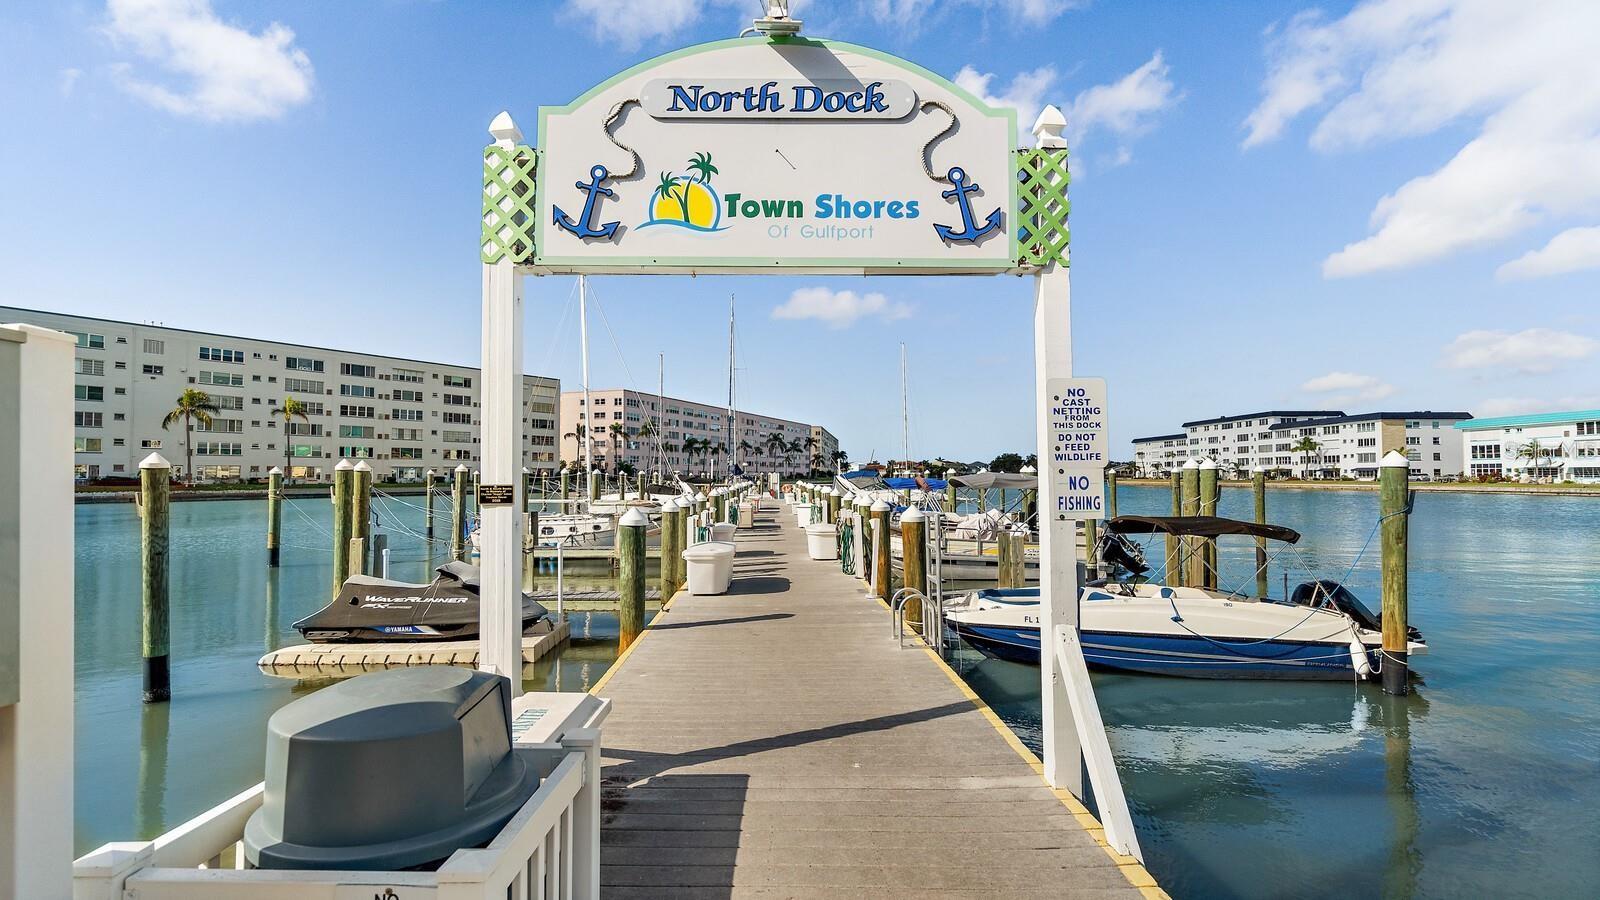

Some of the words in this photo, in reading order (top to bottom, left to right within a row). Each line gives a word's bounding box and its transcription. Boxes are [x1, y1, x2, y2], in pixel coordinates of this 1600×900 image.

[666, 82, 785, 113] North
[789, 81, 890, 113] Dock
[724, 193, 804, 218] Town
[814, 193, 920, 219] Shores
[767, 225, 790, 238] Of
[800, 224, 874, 241] Gulfport
[1067, 388, 1085, 397] NO
[1062, 398, 1091, 406] CAST
[1053, 407, 1101, 415] NETTING
[1076, 421, 1102, 429] DOCK
[1058, 433, 1073, 442] DO
[1075, 433, 1096, 441] NOT
[1064, 443, 1090, 451] FEED
[1054, 453, 1102, 461] WILDLIFE
[1068, 476, 1089, 491] NO
[1058, 495, 1101, 511] FISHING
[1024, 615, 1033, 623] FL
